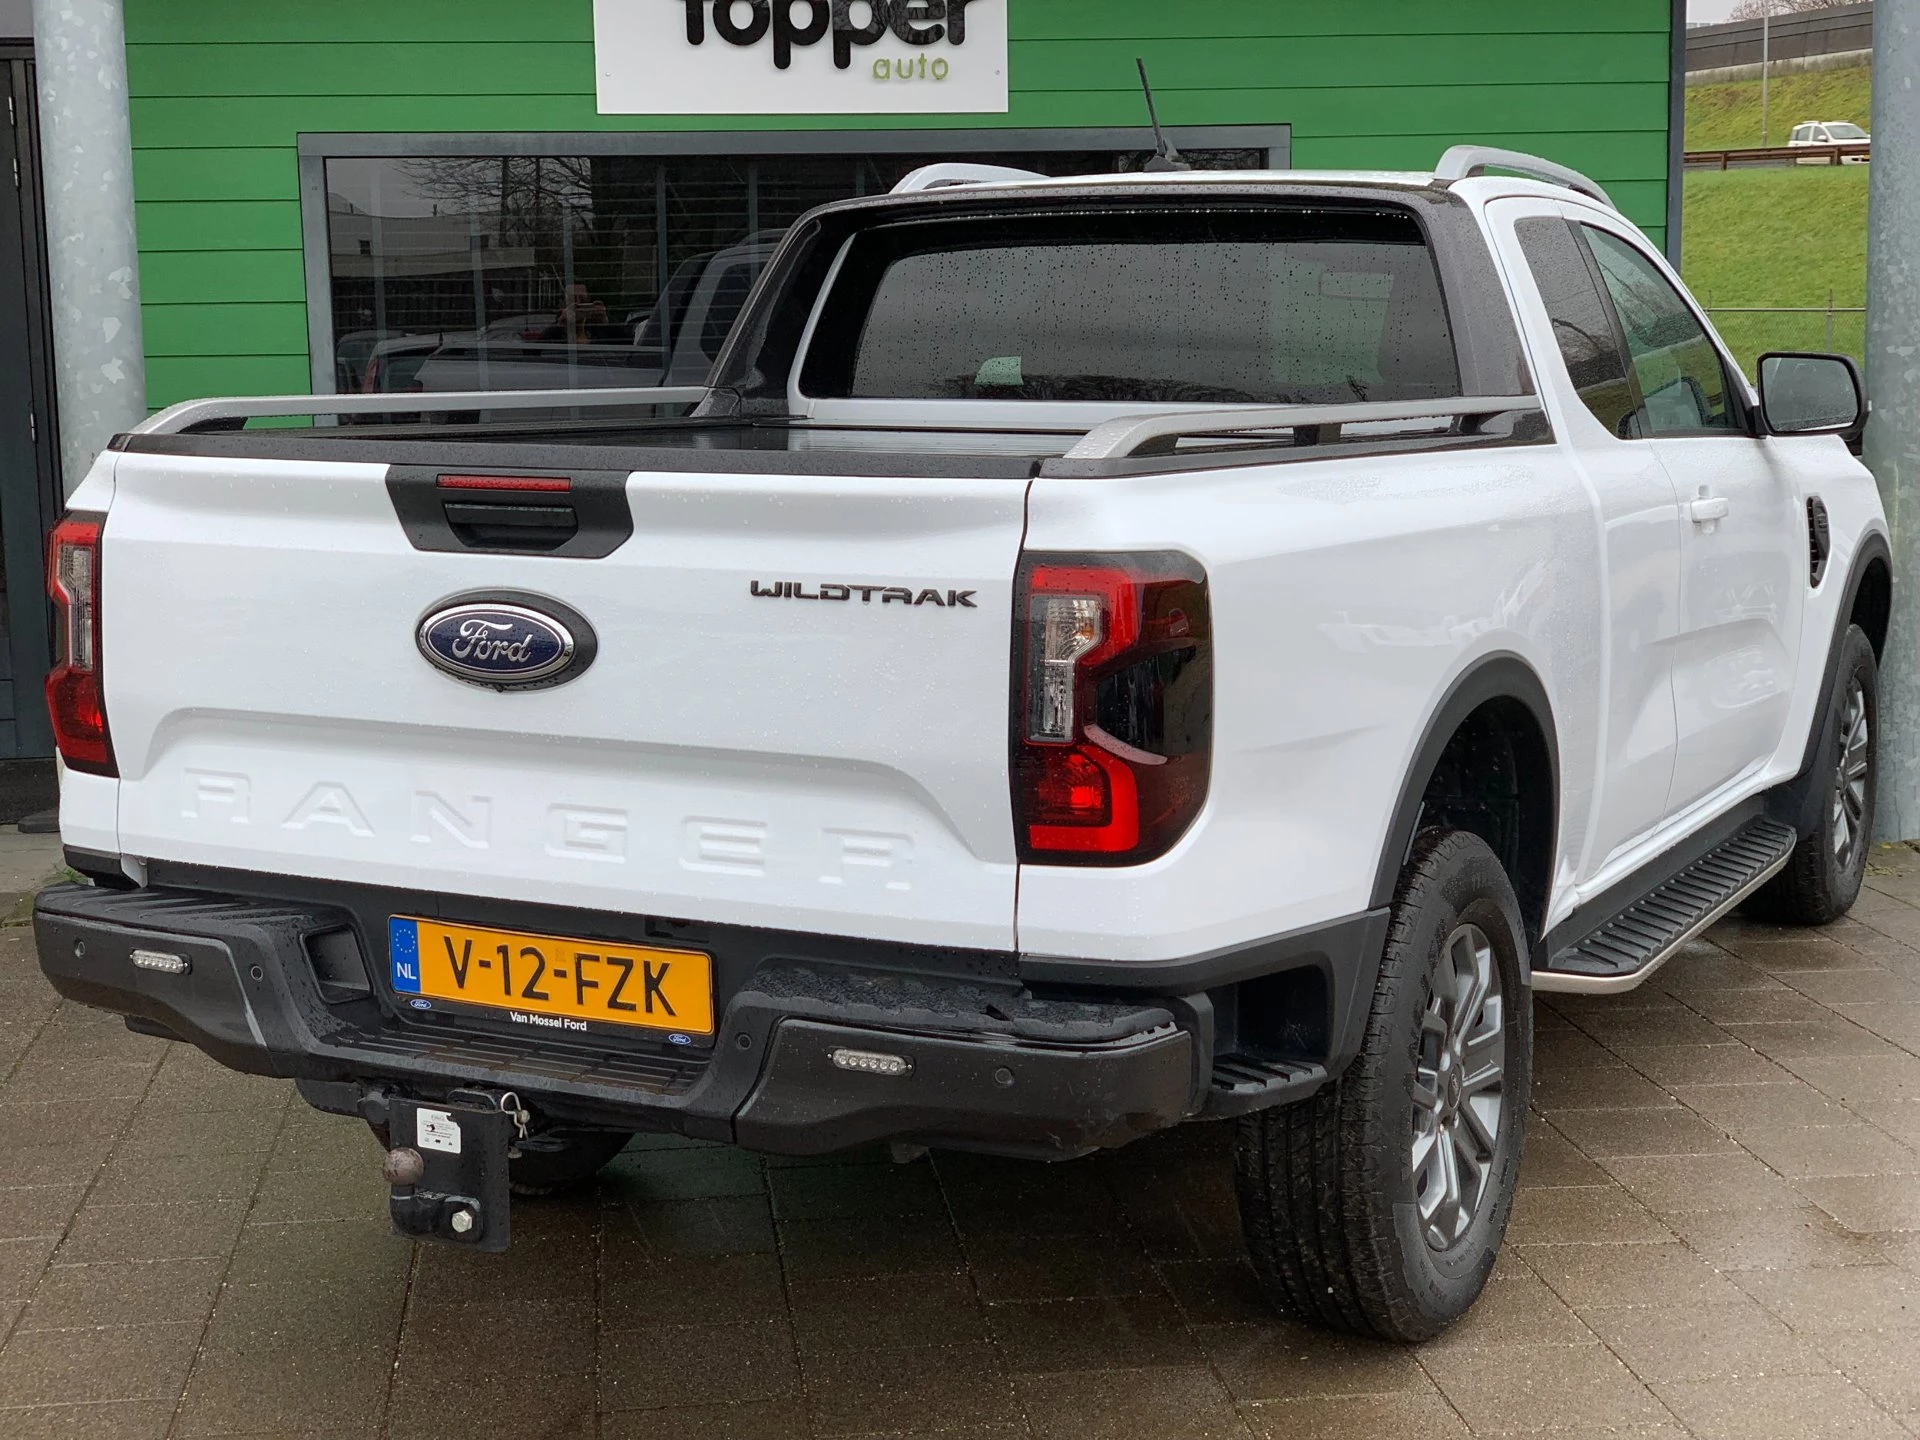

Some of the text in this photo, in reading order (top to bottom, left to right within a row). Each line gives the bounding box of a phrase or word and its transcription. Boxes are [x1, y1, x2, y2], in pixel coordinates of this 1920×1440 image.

[872, 52, 949, 80] auto
[751, 579, 978, 608] WILDTRAK
[451, 619, 532, 663] Ford
[180, 767, 914, 892] RANGER
[396, 962, 417, 981] NL
[443, 935, 678, 1017] V-12-FZK
[510, 1011, 588, 1032] Van Mossel Ford
